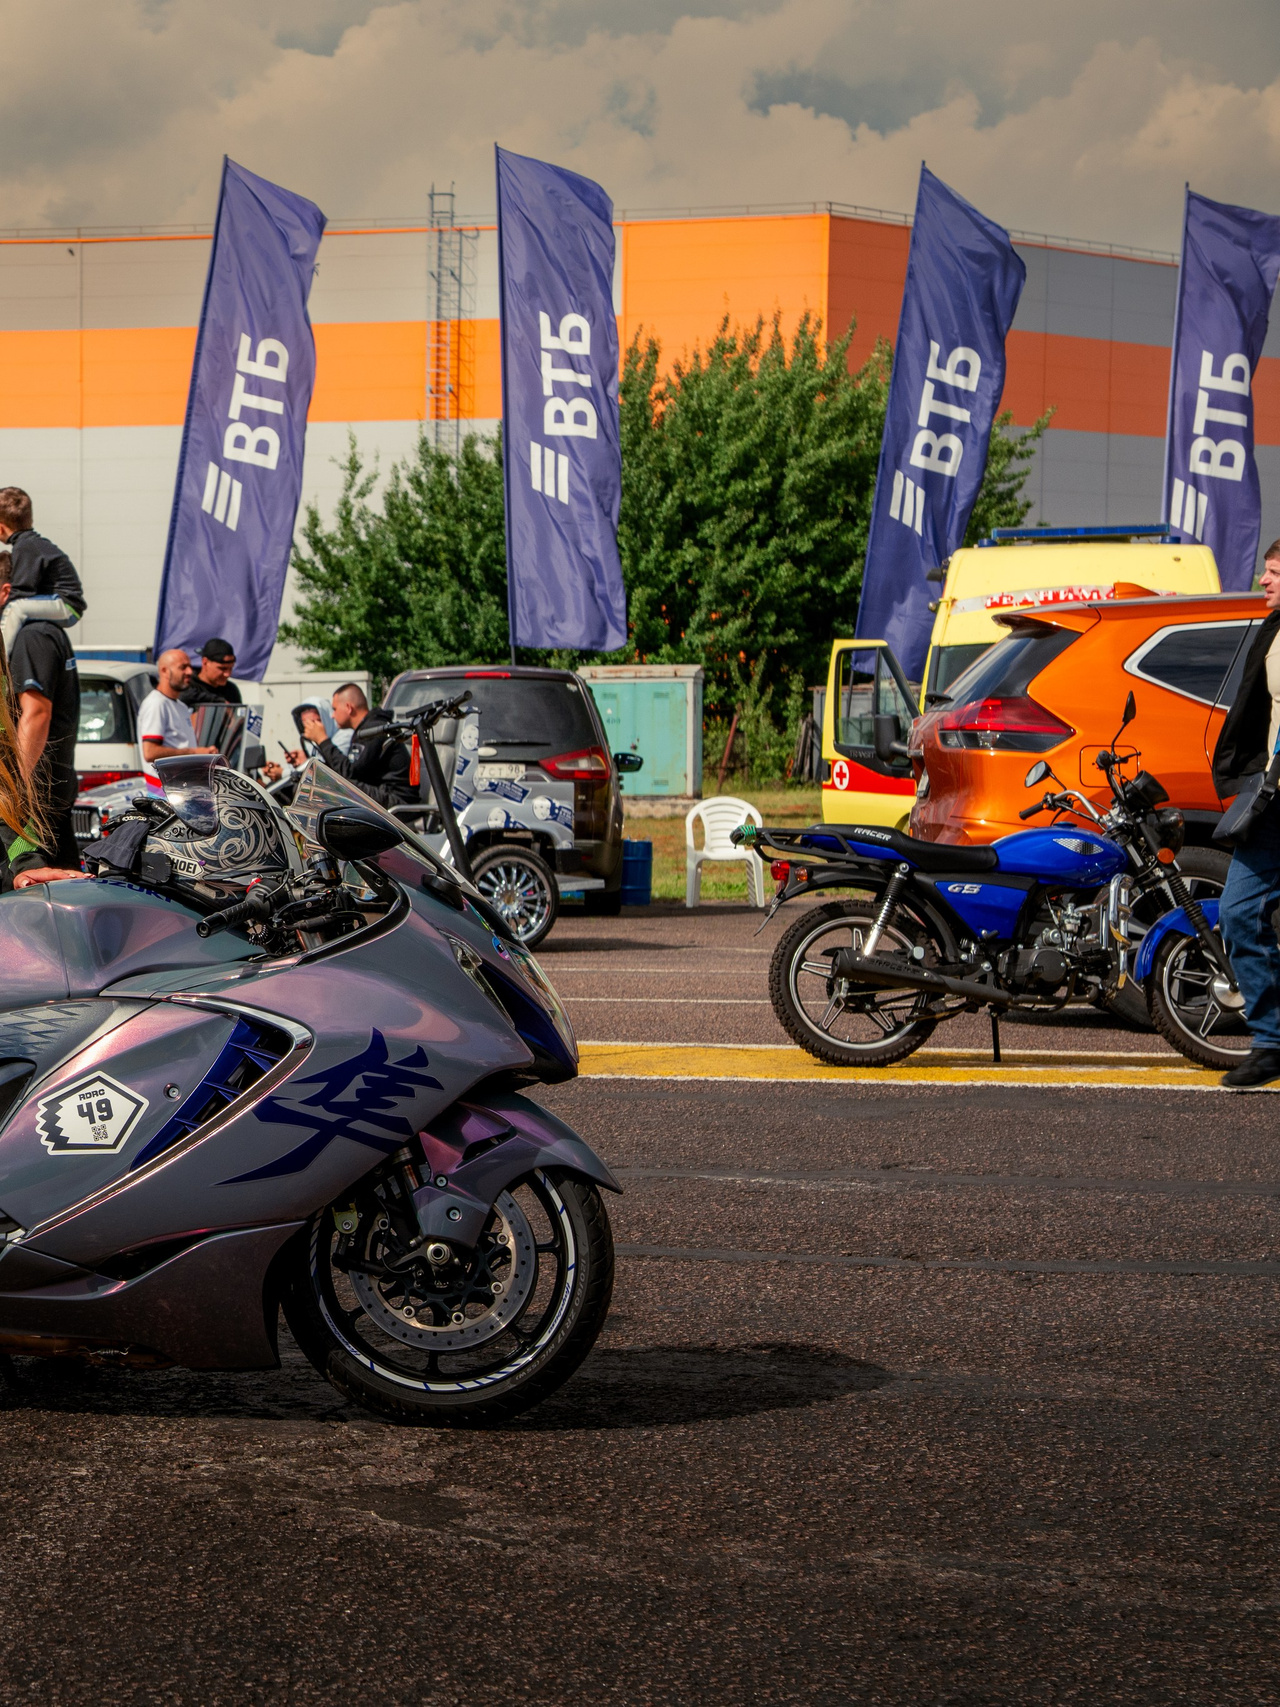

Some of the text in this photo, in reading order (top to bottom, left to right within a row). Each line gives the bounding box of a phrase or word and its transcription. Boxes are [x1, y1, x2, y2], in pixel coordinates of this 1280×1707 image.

[223, 332, 289, 470] ВТБ
[539, 311, 597, 439] ВТБ
[910, 340, 981, 478] ВТБ
[1189, 350, 1251, 481] ВТБ
[173, 856, 197, 875] HOEI
[854, 827, 892, 842] RACER
[77, 1098, 114, 1125] 49
[78, 1089, 106, 1101] RDRC
